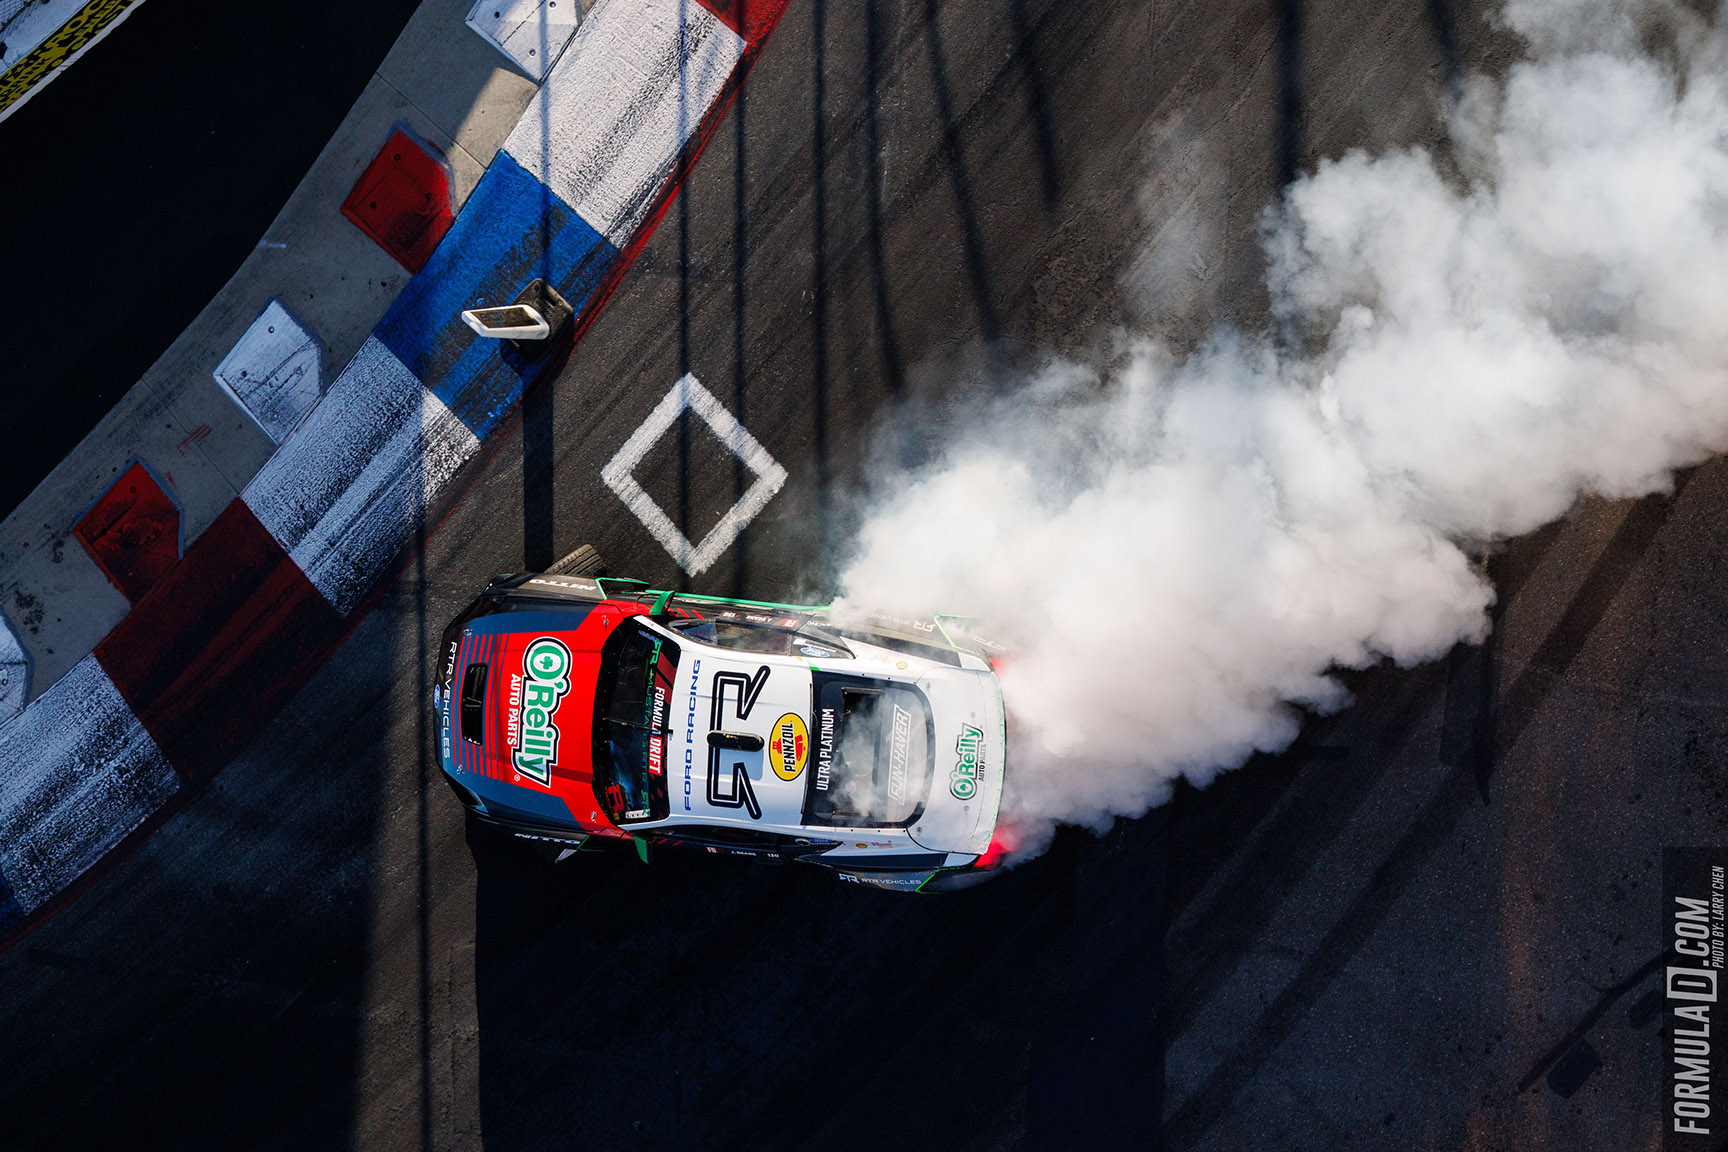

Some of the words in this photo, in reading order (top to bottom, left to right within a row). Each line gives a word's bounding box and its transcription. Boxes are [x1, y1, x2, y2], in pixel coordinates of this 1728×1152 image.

[530, 577, 596, 591] NITTO
[446, 641, 458, 676] RTR
[508, 673, 521, 706] AUTO
[686, 660, 700, 744] RACING
[442, 677, 452, 759] VEHICLES
[507, 707, 519, 746] PARTS
[515, 644, 572, 777] O'Reilly
[650, 686, 666, 734] FORMULA
[780, 722, 796, 773] PENNZOIL
[820, 708, 834, 759] PLATINUM
[649, 737, 662, 775] DRIFT
[951, 725, 981, 799] O'Reilly
[978, 743, 987, 764] PARTS
[684, 749, 693, 812] FORD
[816, 760, 831, 791] ULTRA
[977, 764, 985, 782] AUTO
[514, 832, 581, 846] NITTO
[881, 877, 922, 885] VEHICLES
